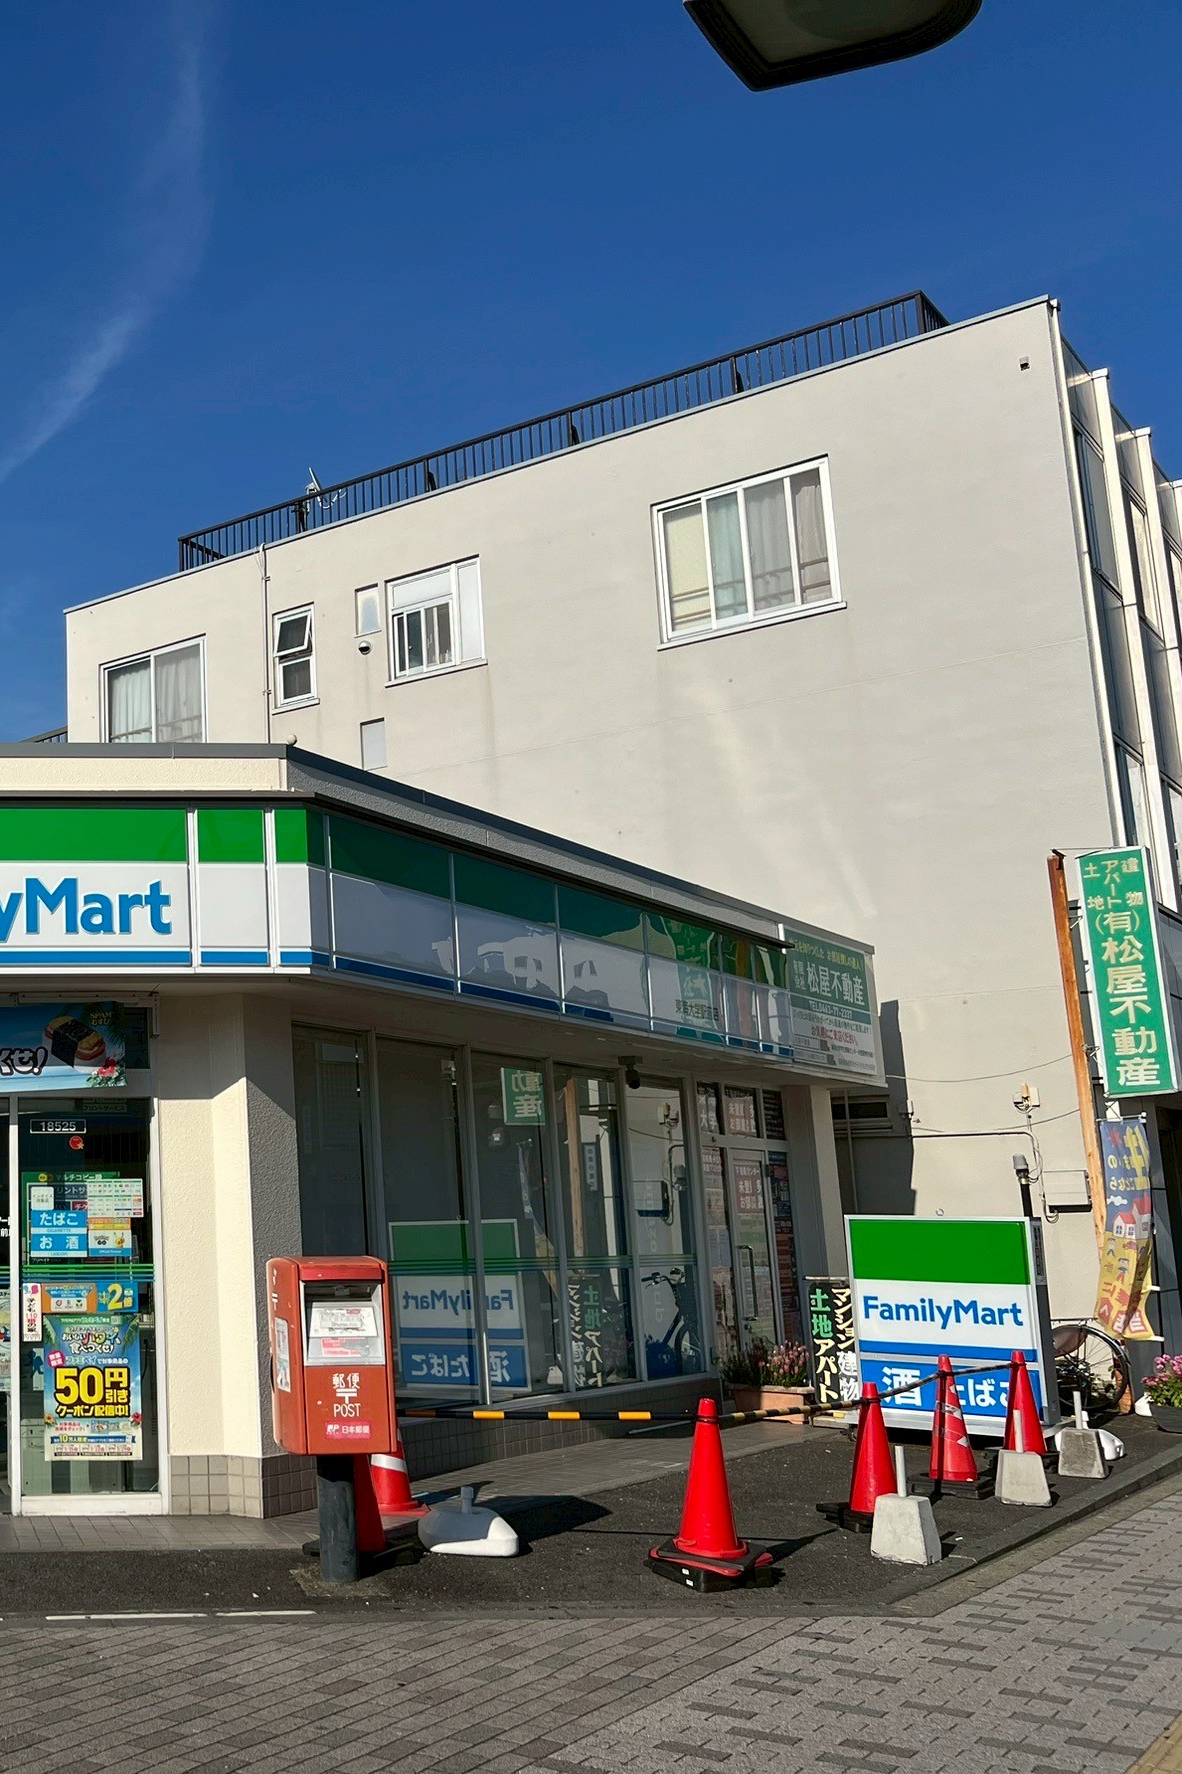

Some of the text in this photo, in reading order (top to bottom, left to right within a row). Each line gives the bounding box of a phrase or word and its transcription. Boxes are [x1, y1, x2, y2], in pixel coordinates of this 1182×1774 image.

[1101, 859, 1122, 912] アパート
[806, 961, 866, 1006] 松屋不動産
[40, 1121, 77, 1132] 18525
[39, 1212, 78, 1226] たばこ
[863, 1295, 1024, 1330] FamilyMart
[332, 1372, 361, 1389] 郵便
[881, 1366, 923, 1408] 酒
[333, 1403, 361, 1418] POST
